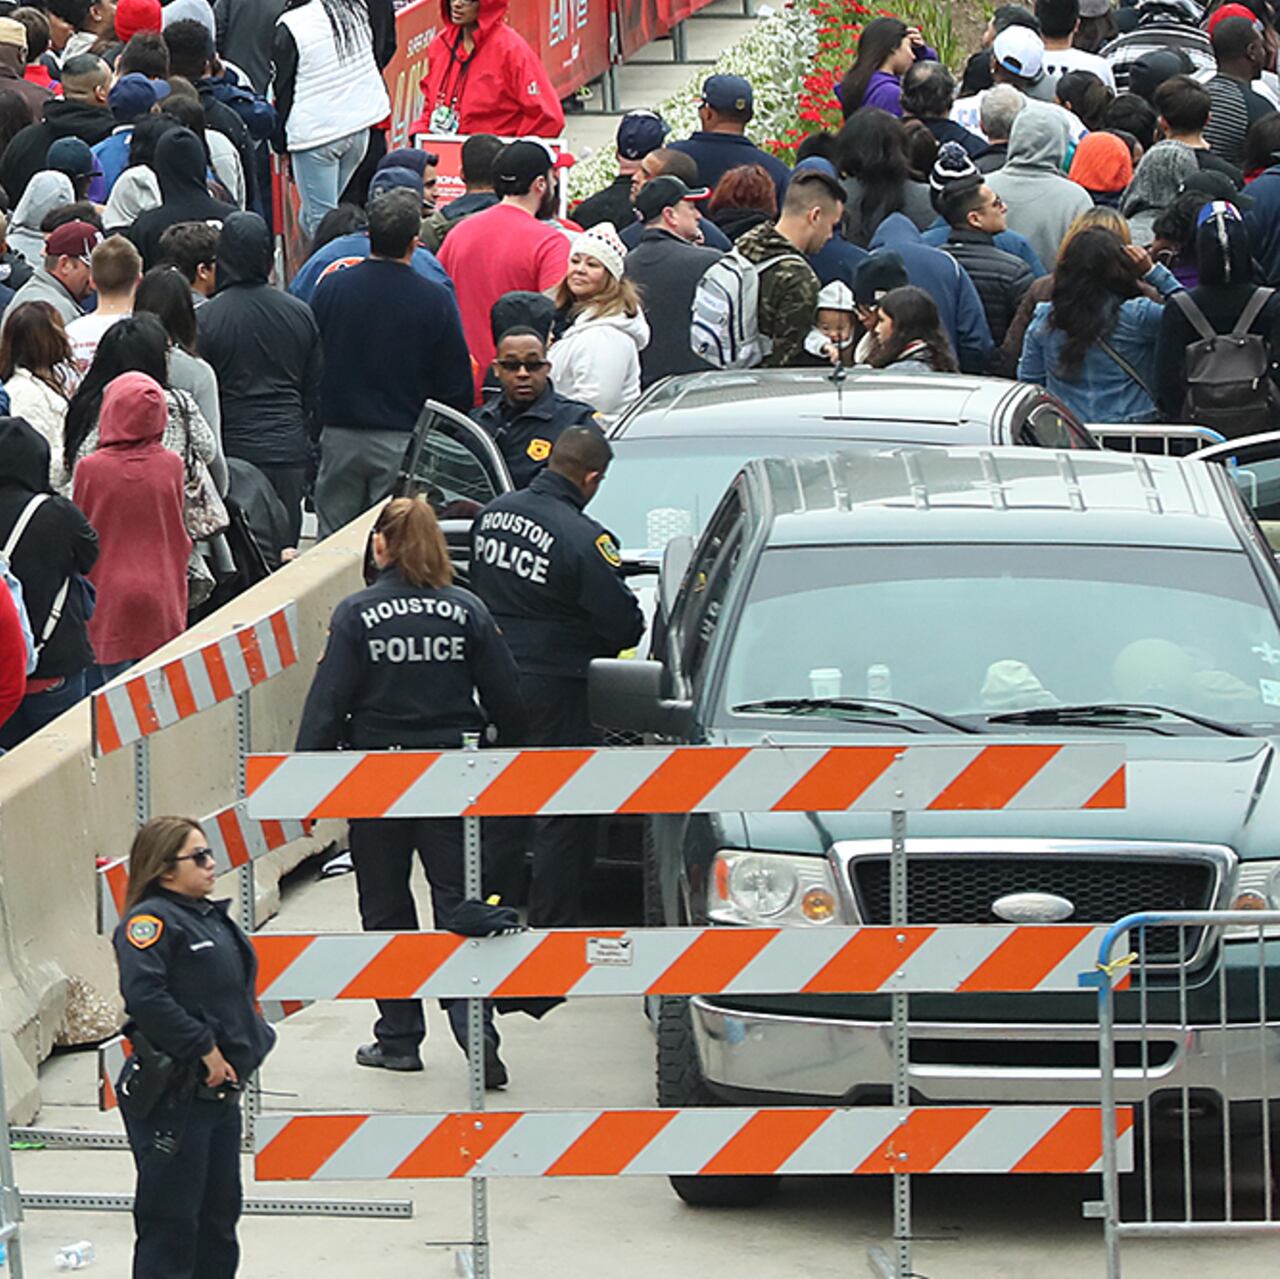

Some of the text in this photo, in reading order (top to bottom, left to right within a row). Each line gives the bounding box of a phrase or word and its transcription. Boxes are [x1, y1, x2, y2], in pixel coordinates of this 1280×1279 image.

[480, 511, 555, 554] HOUSTON
[474, 535, 551, 585] POLICE
[361, 598, 468, 630] HOUSTON
[368, 636, 465, 663] POLICE
